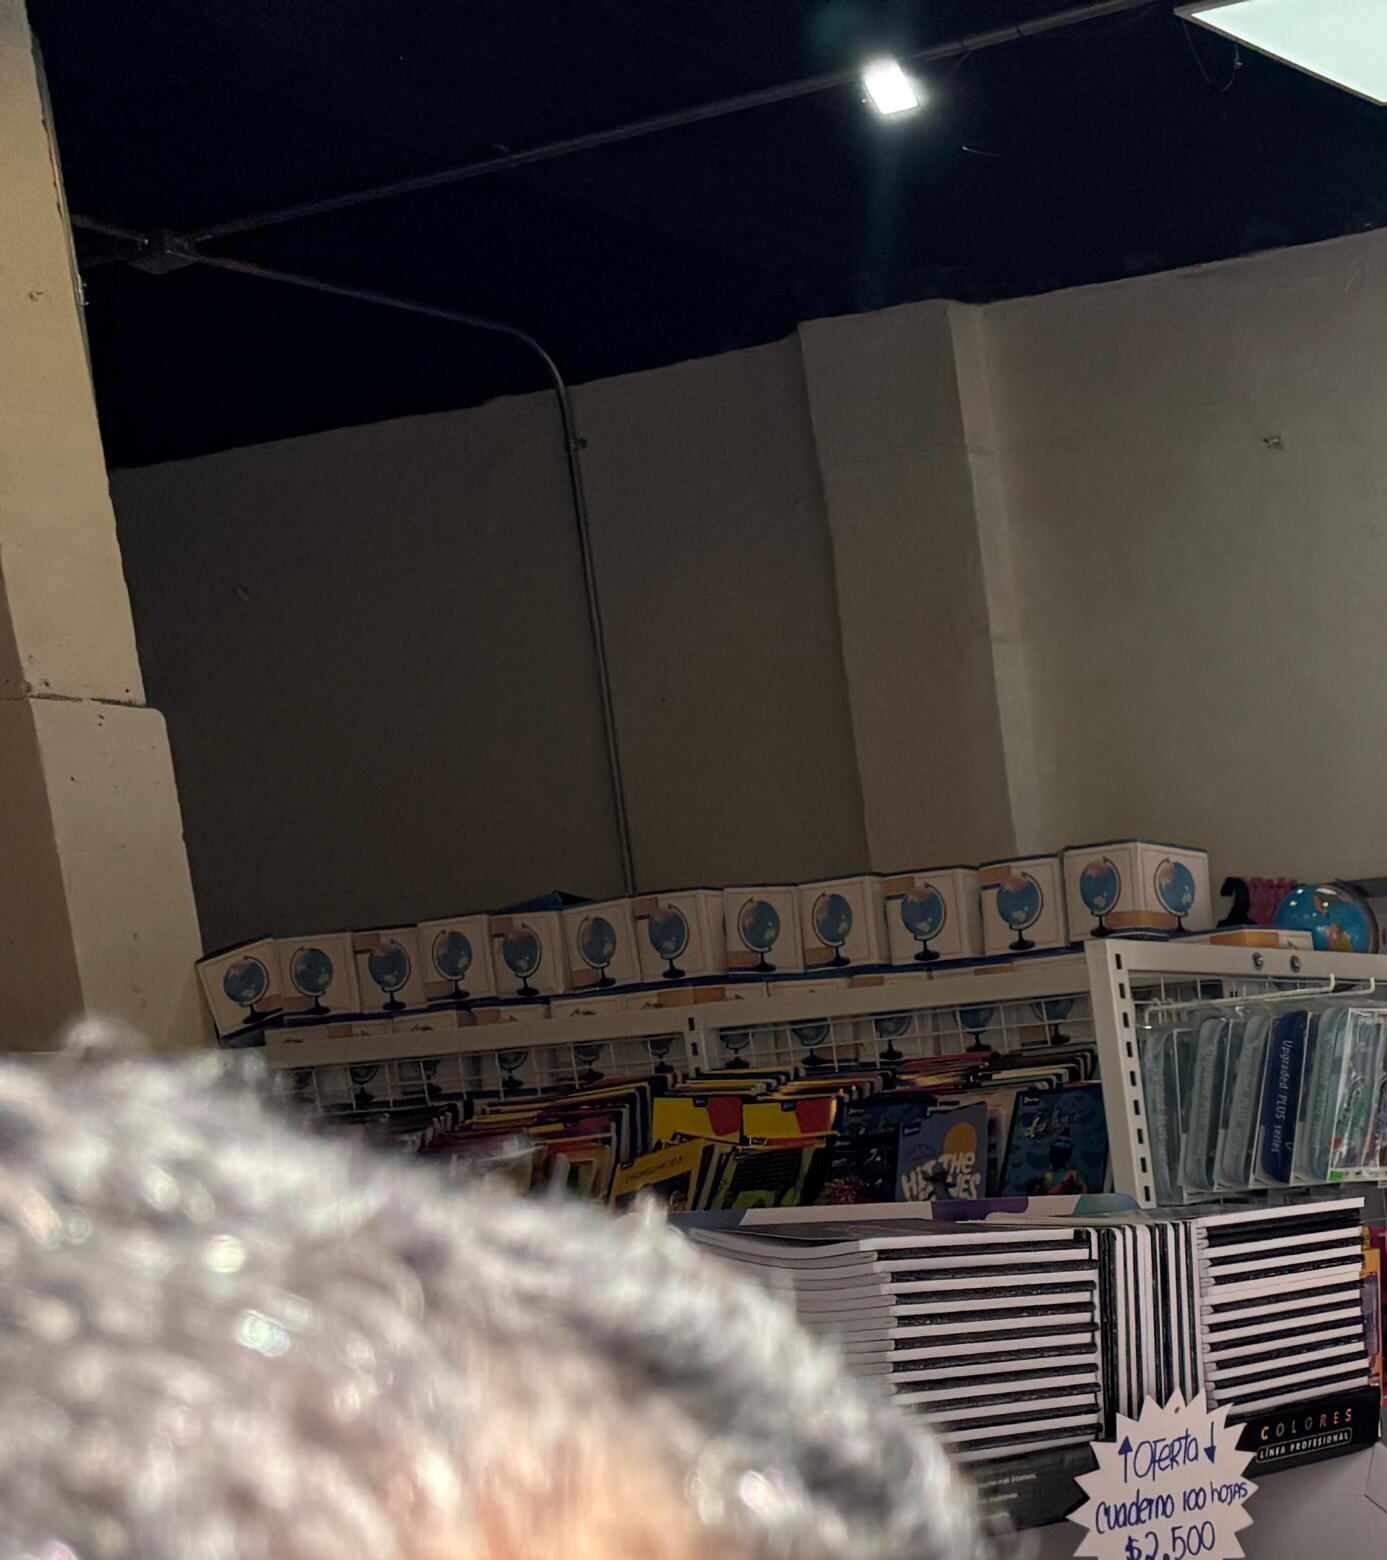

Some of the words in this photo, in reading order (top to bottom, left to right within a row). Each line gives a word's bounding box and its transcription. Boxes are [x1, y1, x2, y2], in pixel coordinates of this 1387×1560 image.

[1260, 1408, 1353, 1441] COLORES
[1289, 1431, 1350, 1453] PROFESIONAL
[1182, 1486, 1207, 1512] 100
